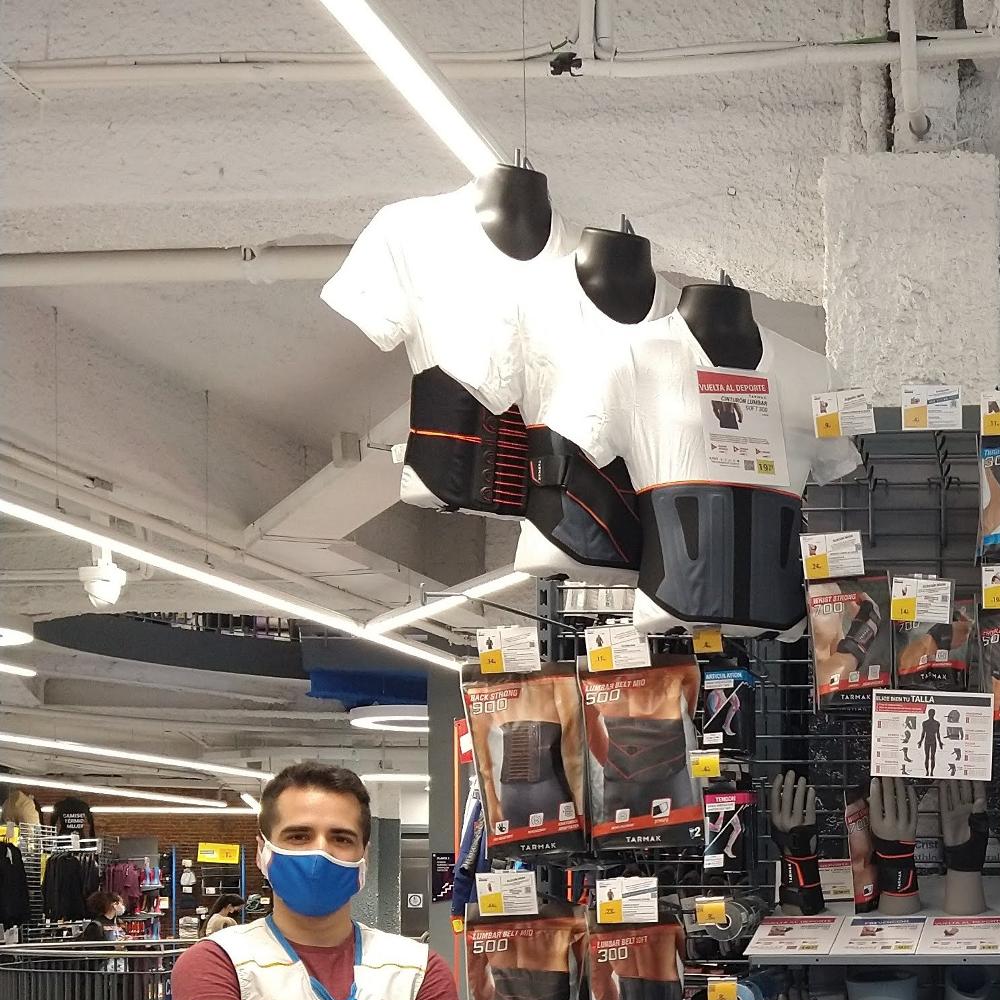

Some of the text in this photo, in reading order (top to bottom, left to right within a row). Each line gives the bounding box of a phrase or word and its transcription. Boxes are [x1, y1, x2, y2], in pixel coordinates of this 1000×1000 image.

[813, 594, 857, 604] WRIST STRONG
[814, 602, 844, 616] 700
[705, 672, 742, 680] ARTICULATION
[615, 681, 631, 689] BELT
[470, 689, 518, 702] BACK STRONG
[585, 689, 620, 706] 500
[911, 695, 934, 703] TALLA
[472, 698, 508, 715] 900
[520, 843, 557, 851] TARMAK
[472, 931, 501, 941] LUMBAR
[472, 939, 508, 953] 500
[597, 939, 621, 948] LUMBAR
[621, 937, 635, 946] BELT
[597, 946, 628, 963] 300
